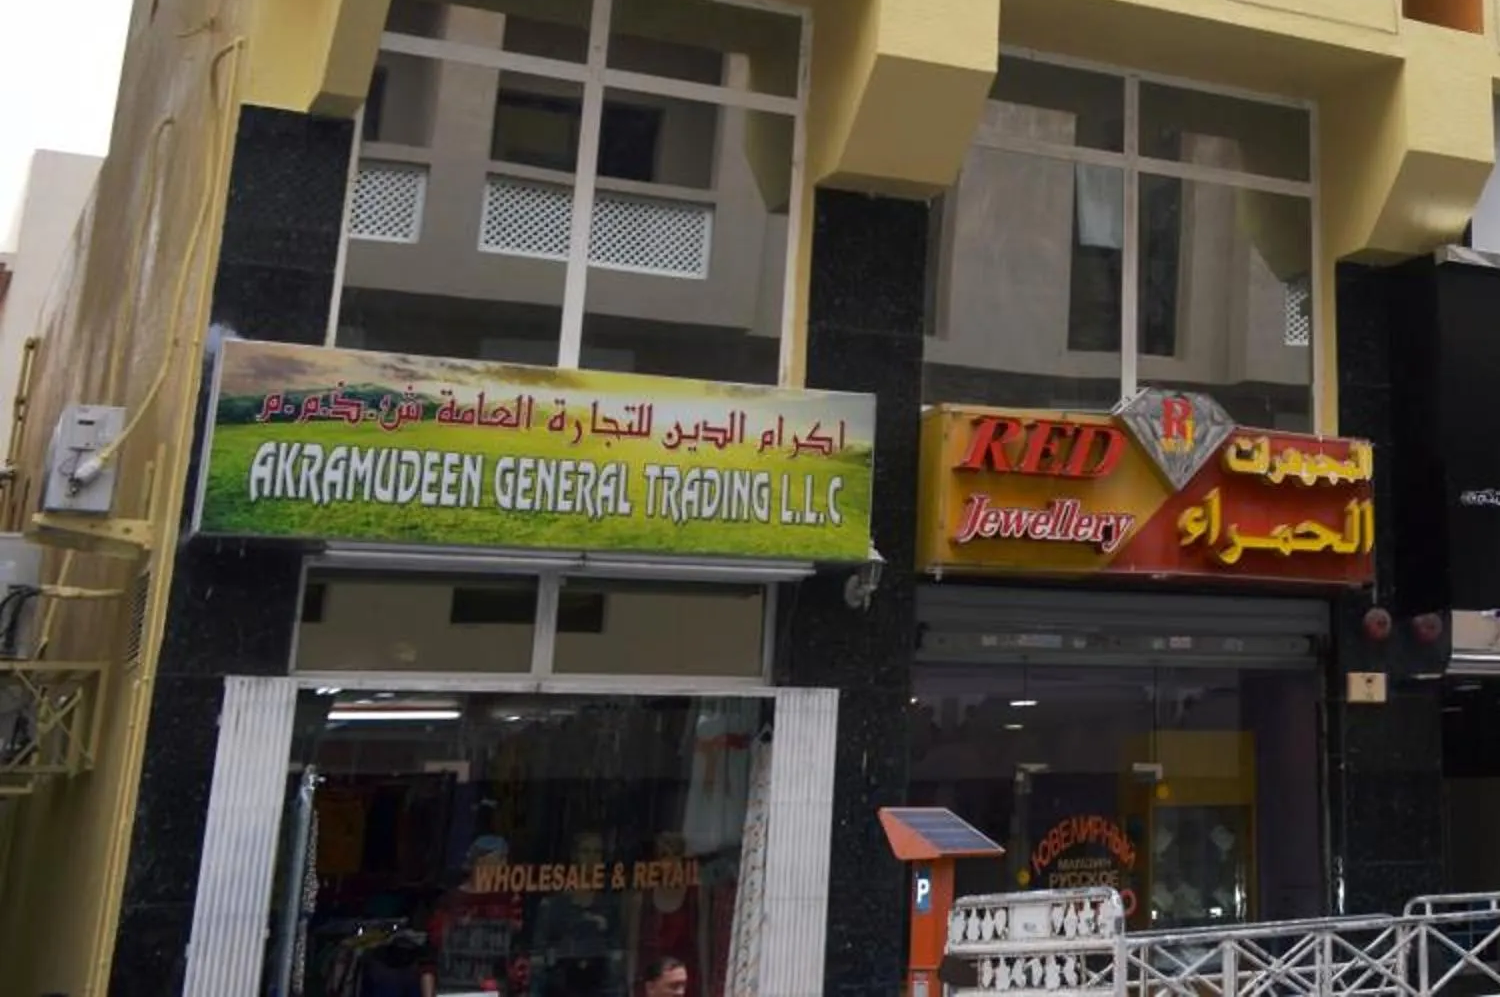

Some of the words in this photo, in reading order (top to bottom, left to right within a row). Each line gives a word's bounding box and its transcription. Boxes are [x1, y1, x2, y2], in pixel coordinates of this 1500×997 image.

[436, 388, 535, 429] العامة
[547, 399, 653, 448] للتجارة
[662, 410, 747, 452] الدين
[758, 413, 846, 458] اكرام
[952, 416, 1128, 478] RED
[250, 441, 484, 508] AKRAMUDEEN
[495, 456, 632, 520] GENERAL
[644, 463, 771, 525] TRADING
[955, 493, 1136, 554] Jewellery
[1177, 486, 1376, 566] الحمراء
[474, 862, 606, 894] WHOLESALE
[611, 861, 626, 890] &
[633, 859, 701, 889] RETAIL
[916, 878, 930, 904] P
